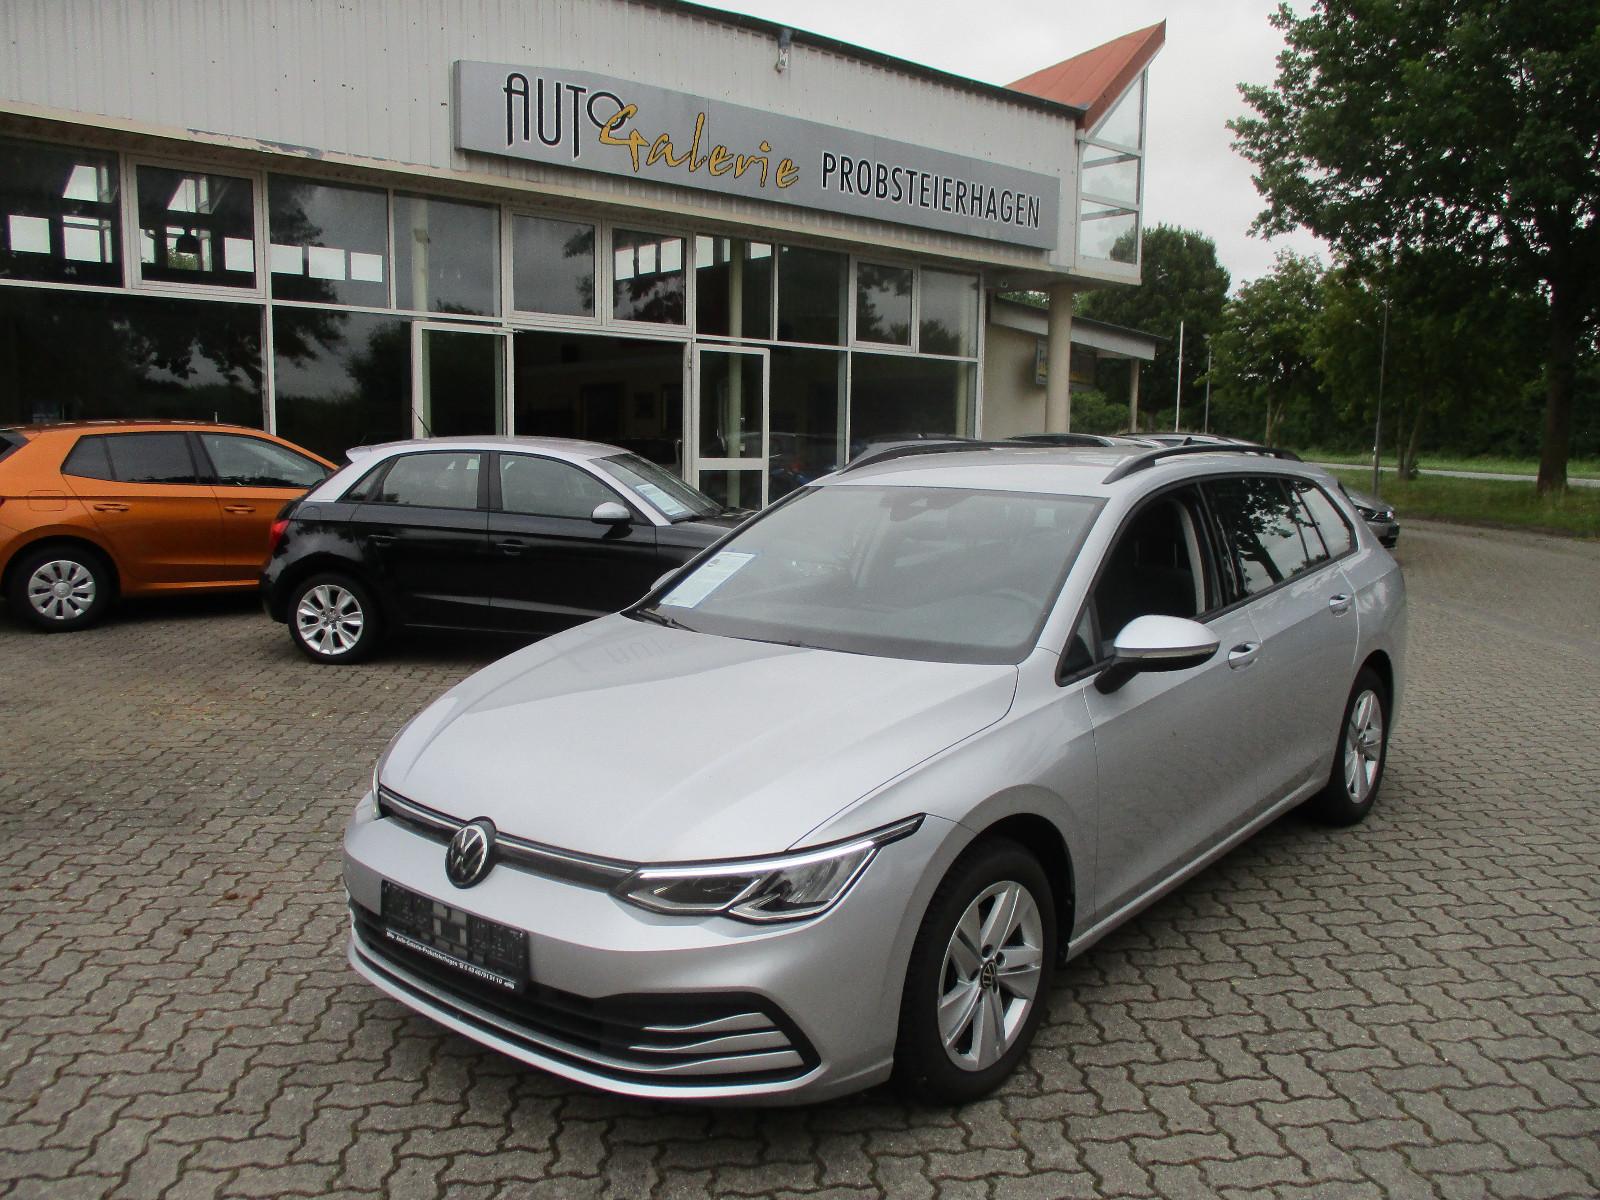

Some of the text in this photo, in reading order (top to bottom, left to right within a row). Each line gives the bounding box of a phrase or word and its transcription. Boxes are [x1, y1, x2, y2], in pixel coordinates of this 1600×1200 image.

[502, 72, 627, 160] AUTO
[599, 103, 799, 189] Galerie
[821, 151, 1041, 230] PROBSTEIERHAGEN
